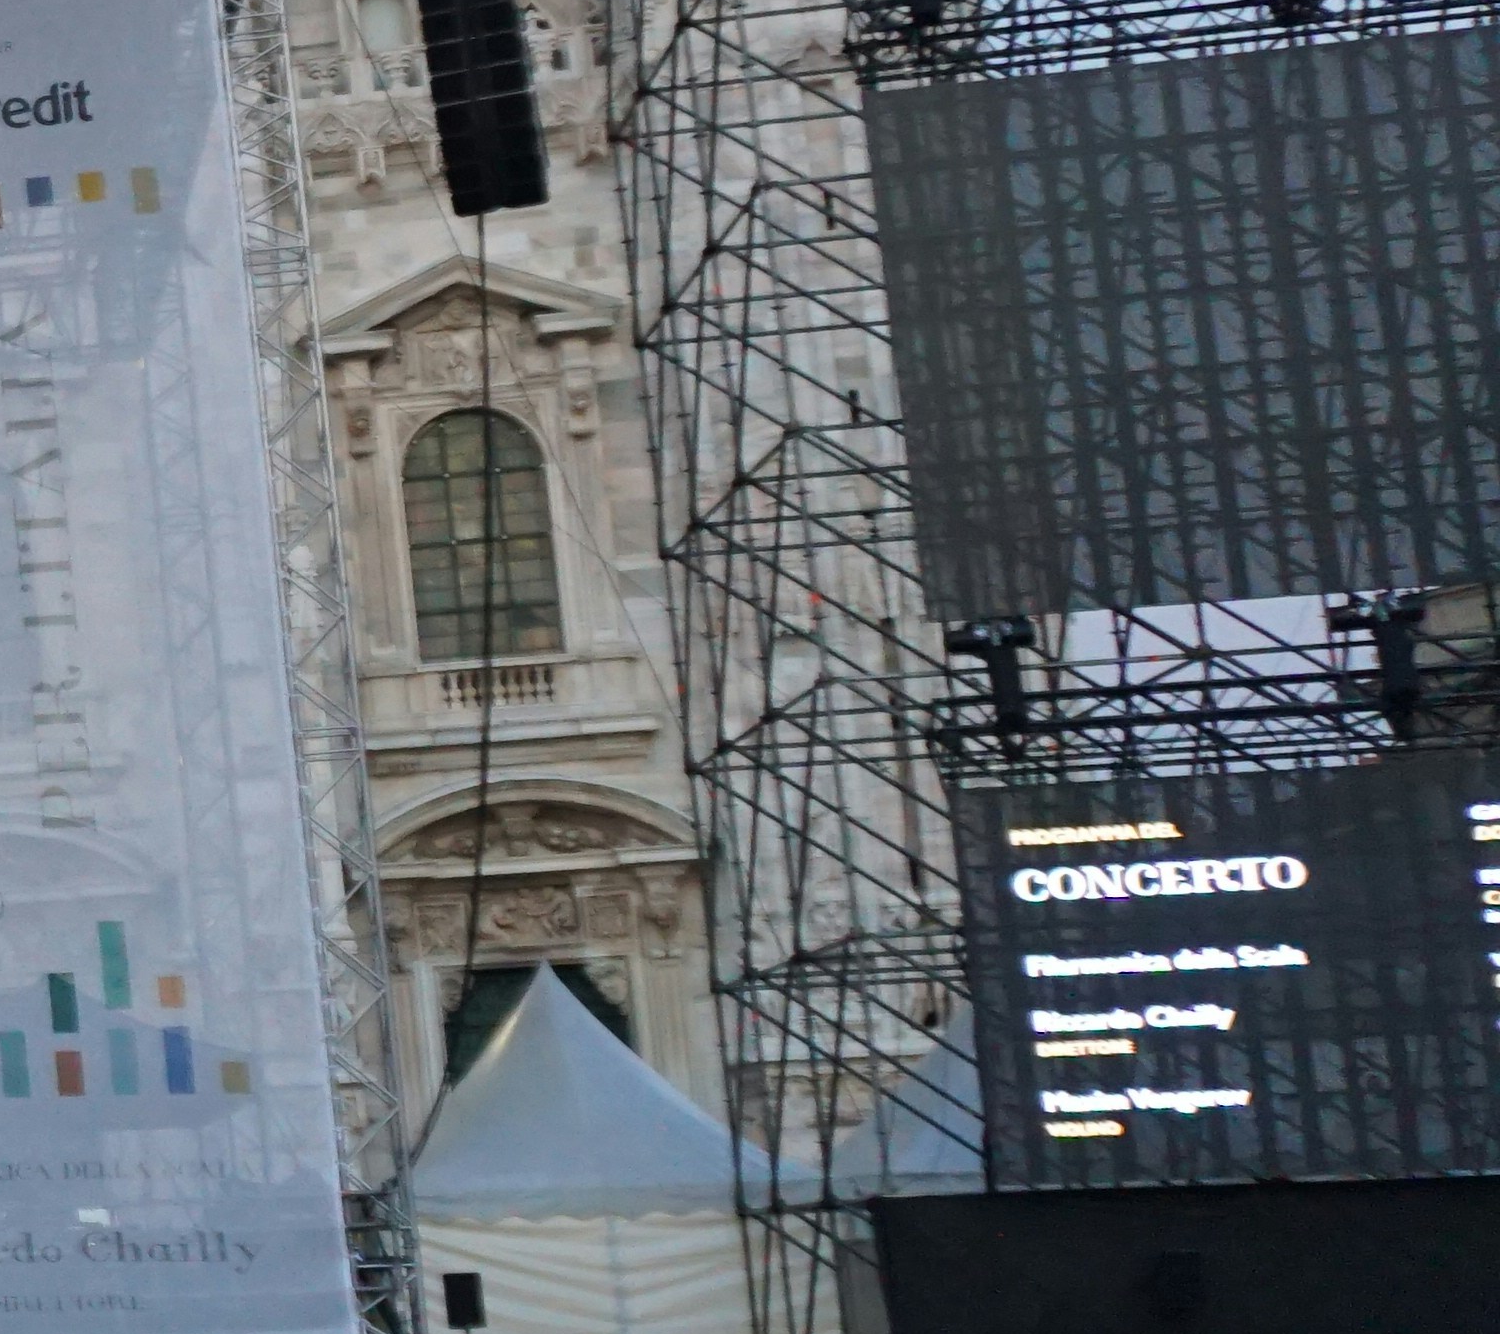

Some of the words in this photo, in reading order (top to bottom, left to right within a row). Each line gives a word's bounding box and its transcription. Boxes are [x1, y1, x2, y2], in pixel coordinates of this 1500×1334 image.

[30, 666, 97, 832] PER
[1012, 855, 1307, 902] CONCERTO
[82, 1229, 260, 1275] Chailly
